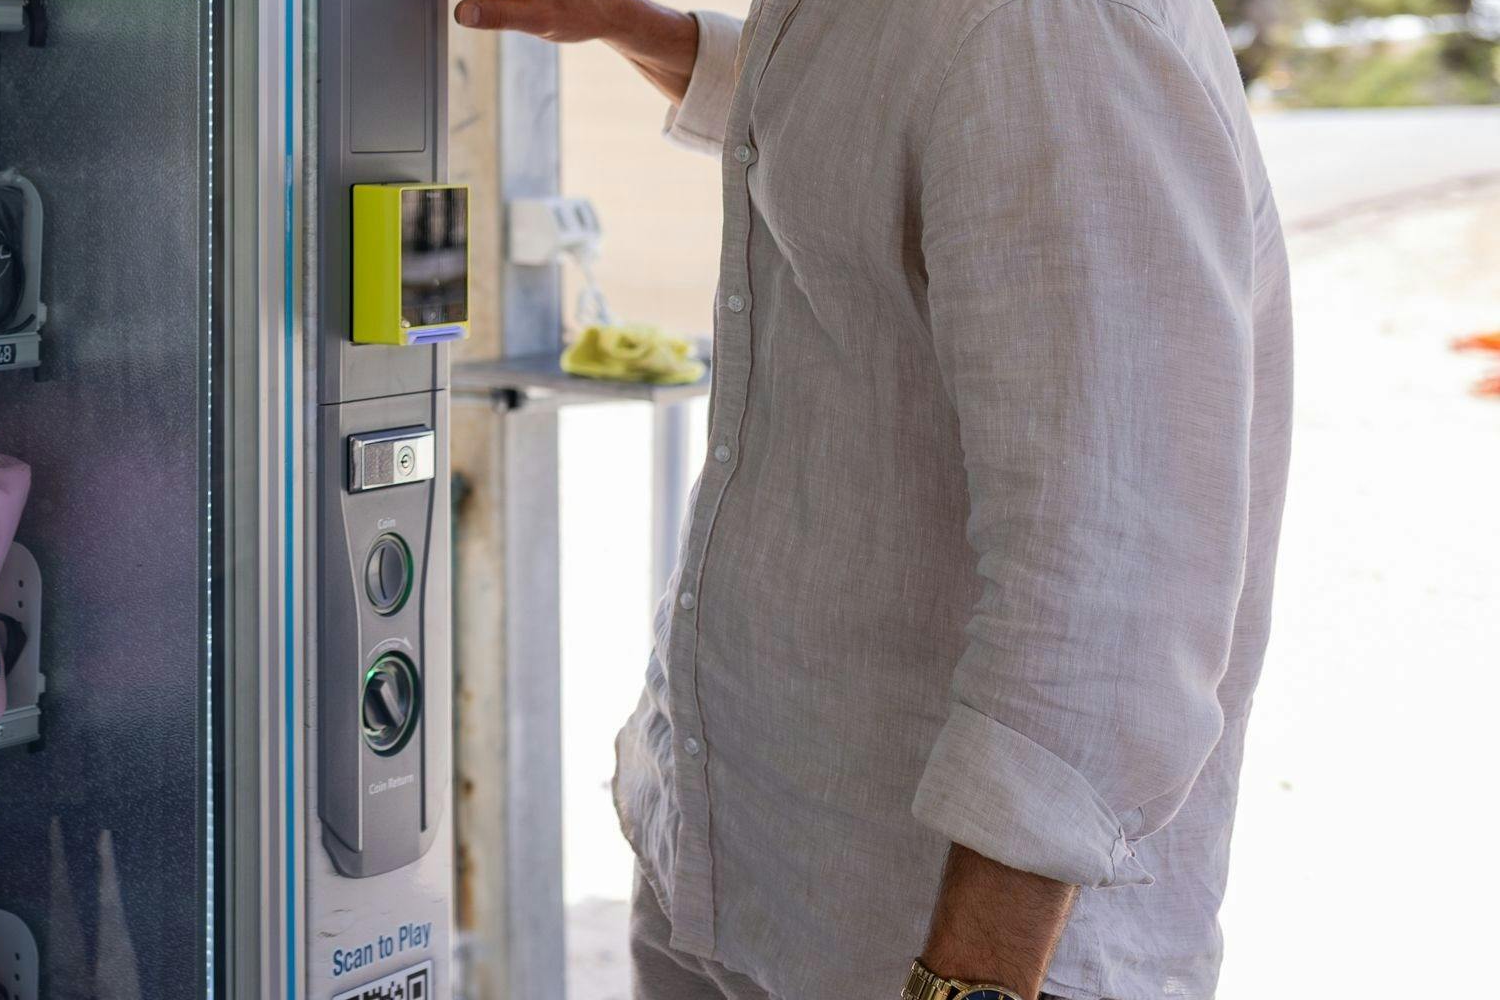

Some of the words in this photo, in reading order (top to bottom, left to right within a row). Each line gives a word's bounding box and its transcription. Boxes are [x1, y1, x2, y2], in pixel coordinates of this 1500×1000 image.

[377, 517, 396, 531] Coin
[368, 781, 388, 796] Coin
[388, 773, 415, 791] Return
[333, 946, 373, 977] Scan
[378, 934, 393, 959] to
[399, 921, 432, 954] Play
